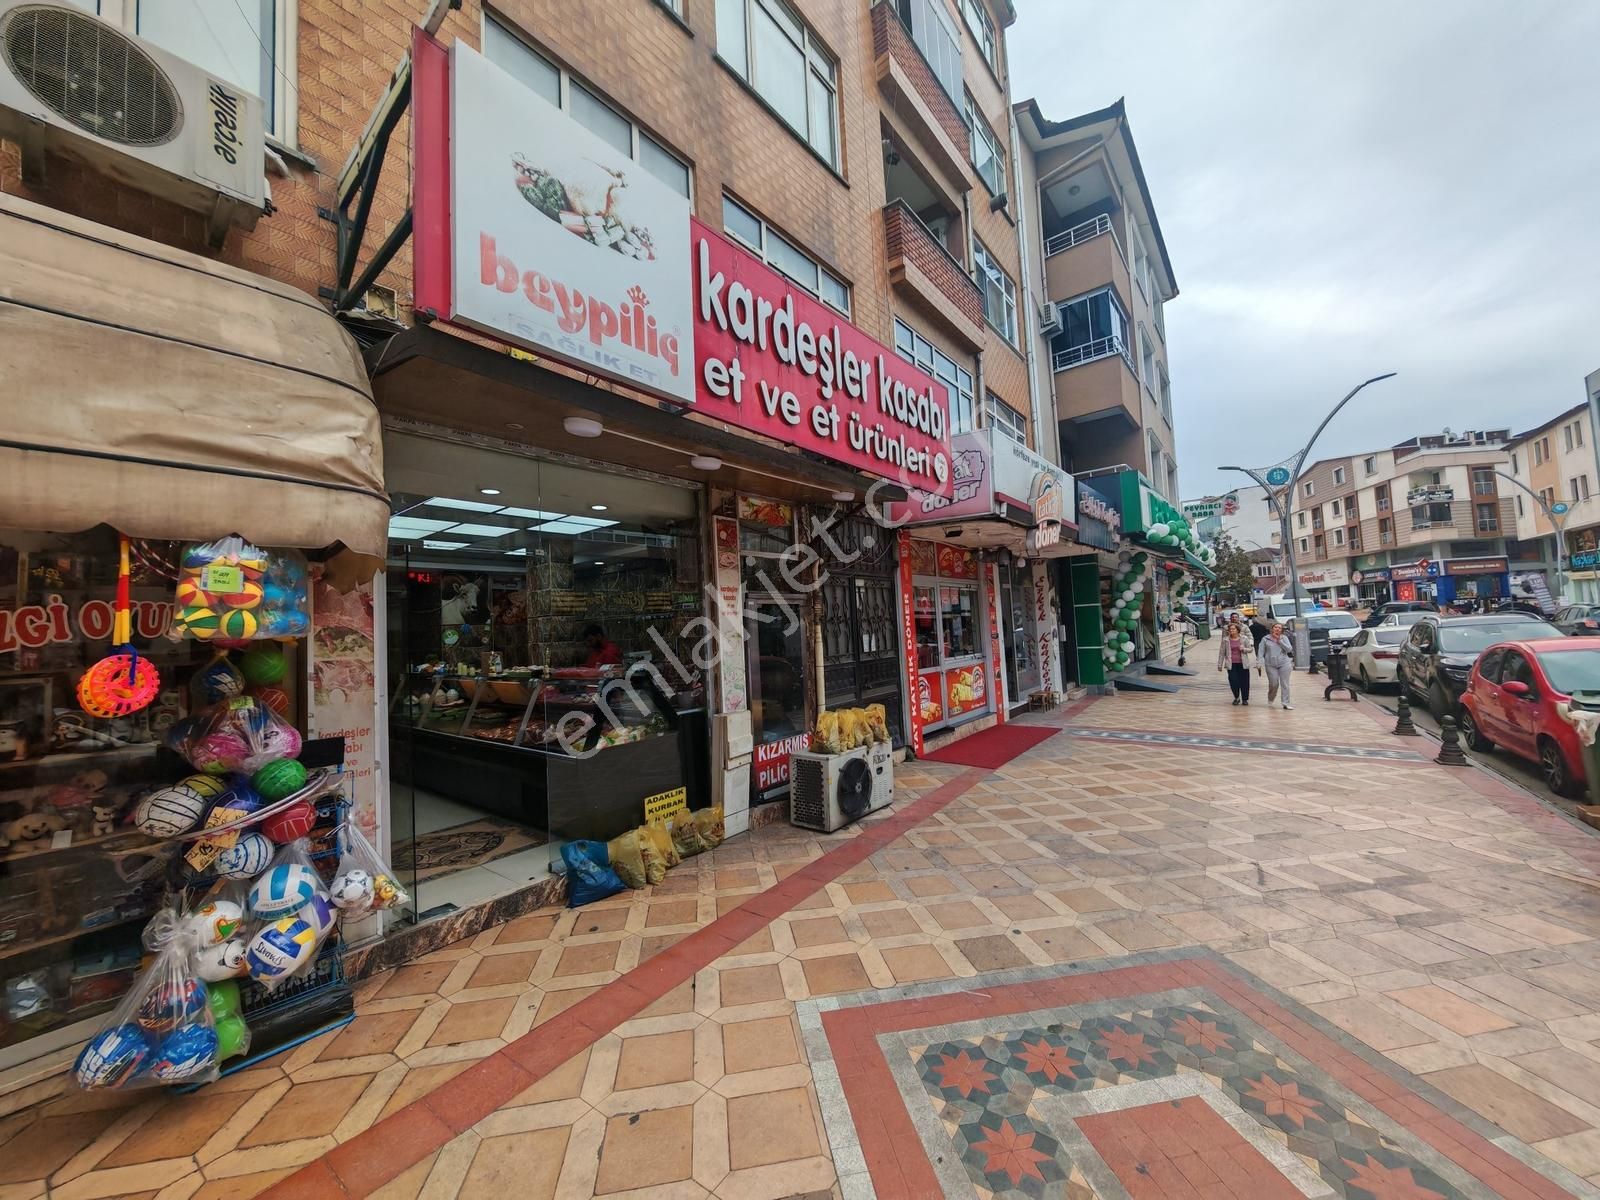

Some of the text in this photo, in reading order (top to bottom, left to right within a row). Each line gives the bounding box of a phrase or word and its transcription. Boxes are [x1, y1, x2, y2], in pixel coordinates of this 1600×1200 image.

[210, 84, 243, 165] arçelik
[515, 322, 659, 383] SAĞLIK ET
[700, 238, 947, 442] kardeşler kasabı
[704, 357, 931, 477] et ve et ürünleri
[1035, 521, 1061, 551] döner
[903, 593, 919, 753] TAT KATTIK DÖNER
[646, 788, 684, 805] ADAKLIK
[648, 798, 684, 815] KURBAN
[760, 763, 788, 789] PİLİÇ
